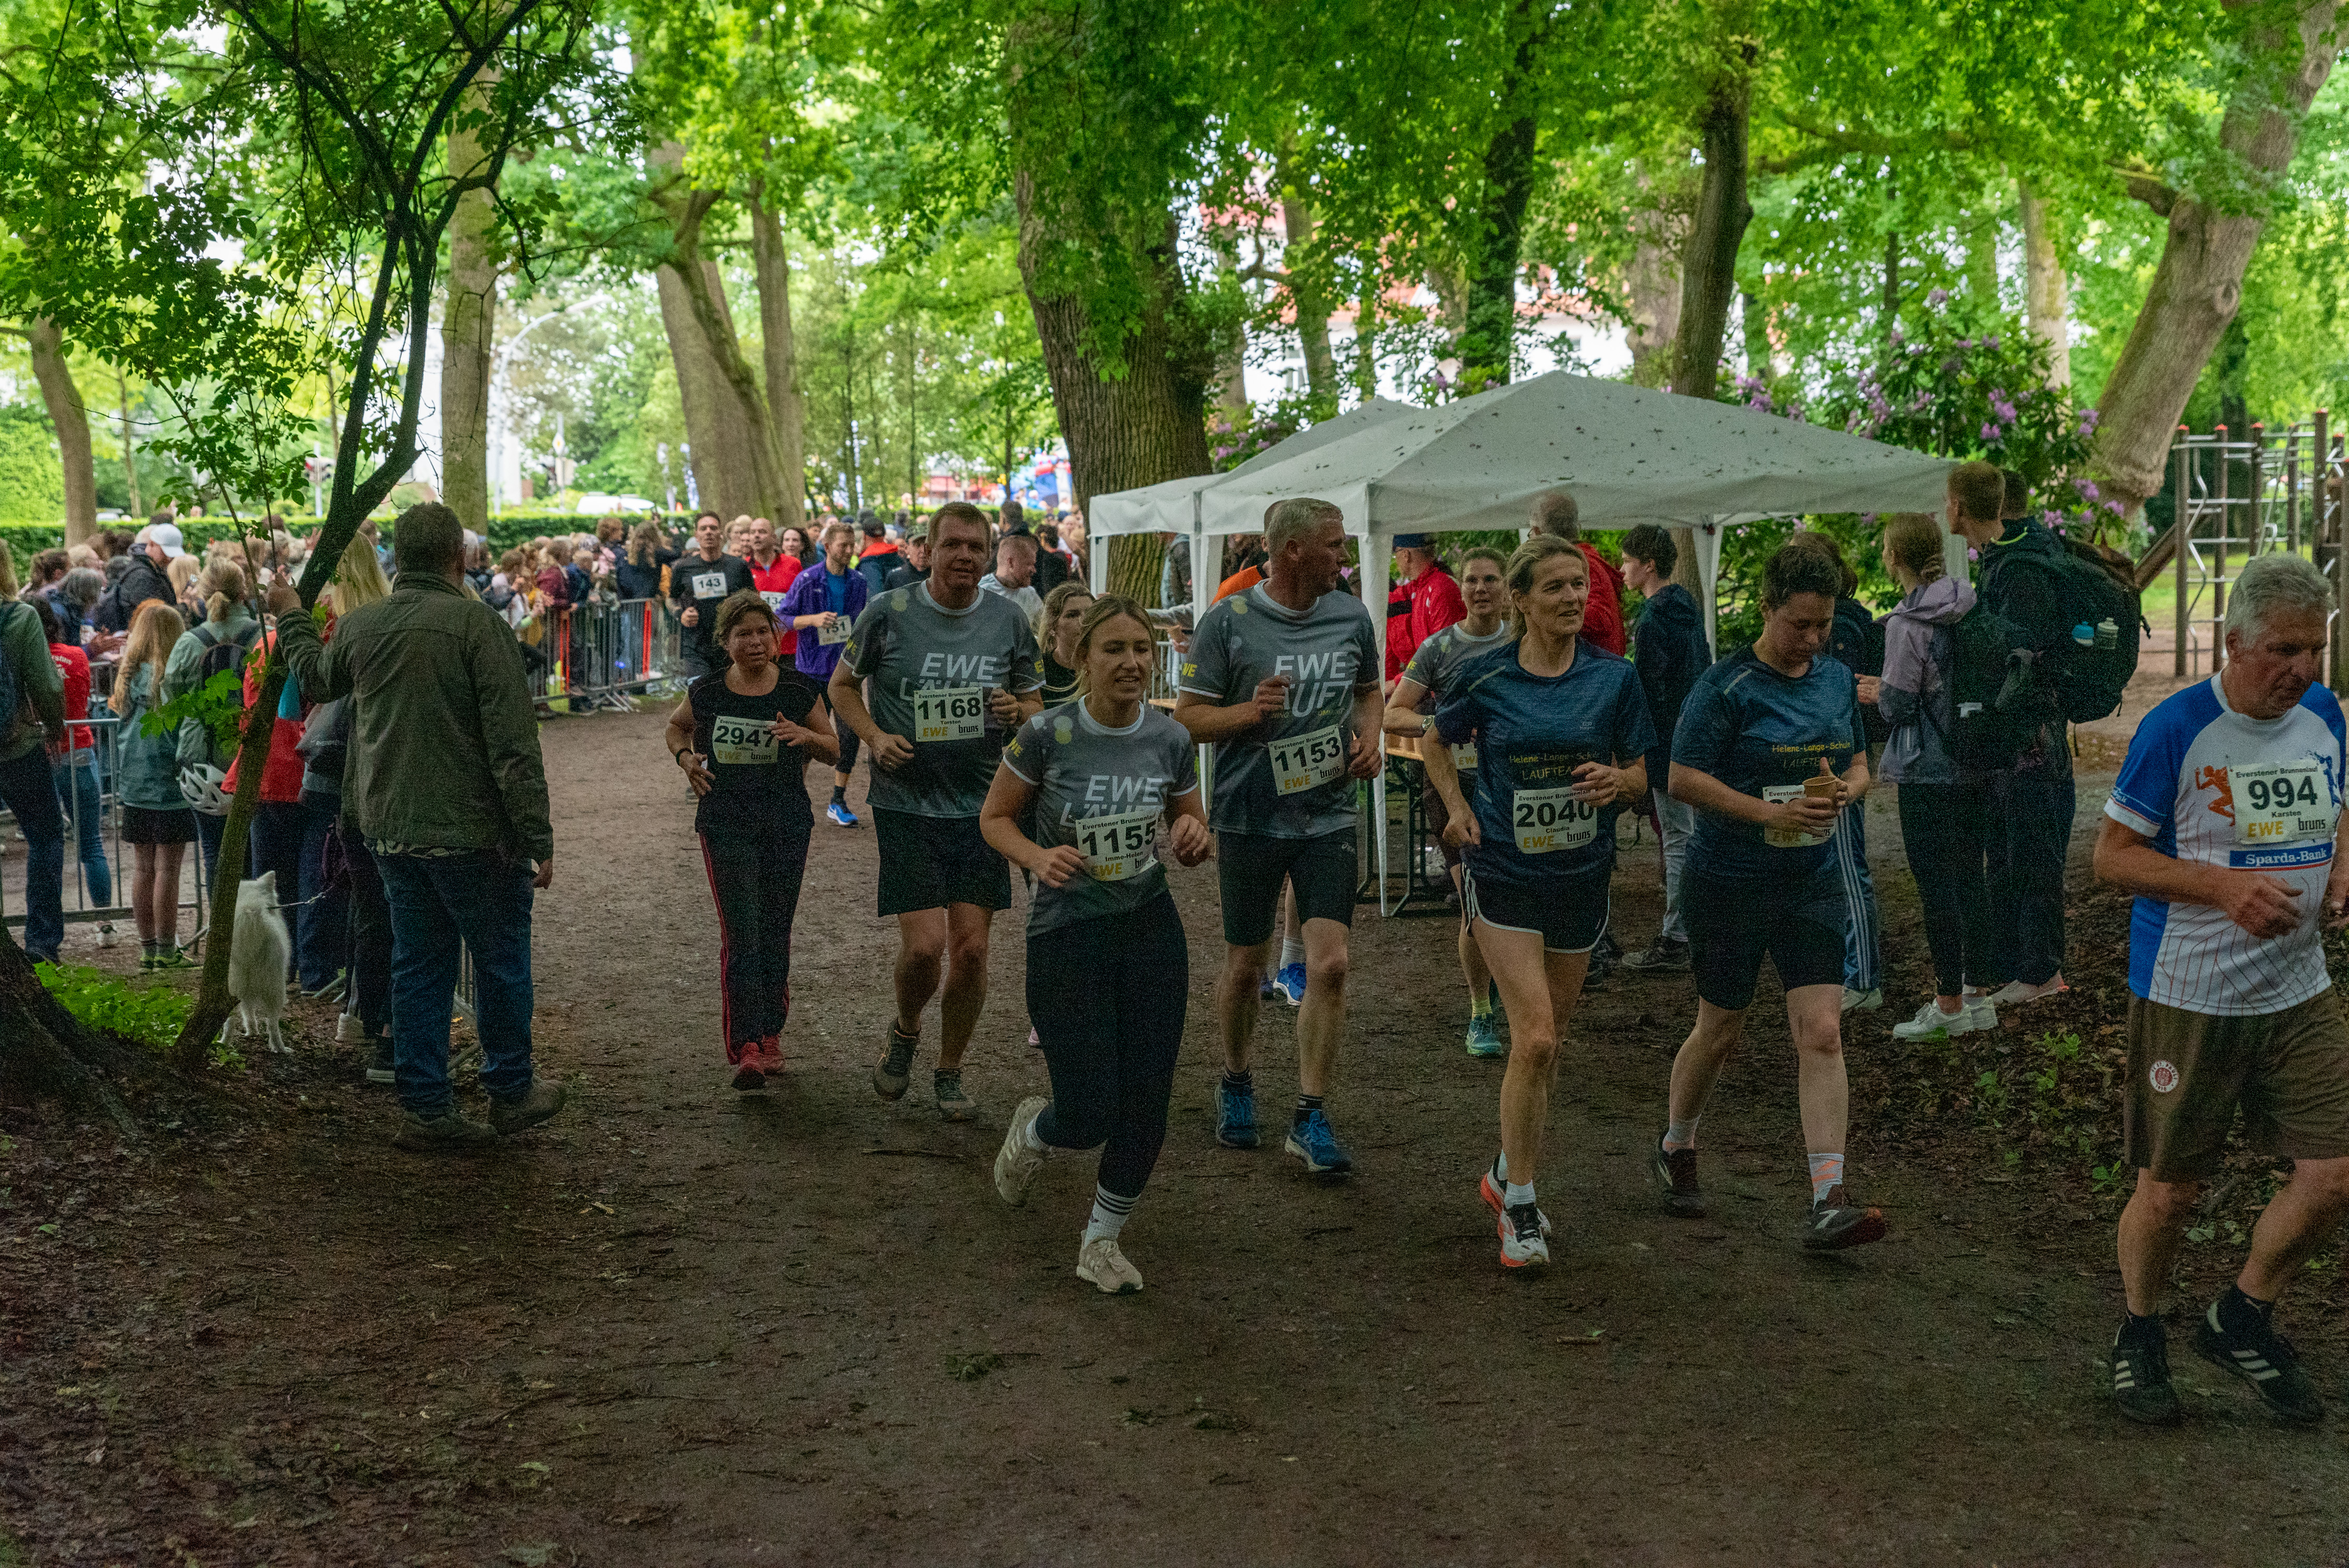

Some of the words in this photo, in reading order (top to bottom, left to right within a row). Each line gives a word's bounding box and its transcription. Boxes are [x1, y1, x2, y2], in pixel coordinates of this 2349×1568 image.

[698, 578, 720, 588] 143
[920, 652, 997, 680] EWE
[918, 697, 981, 720] 1168
[922, 726, 948, 738] EWE
[958, 724, 979, 733] bruns
[714, 725, 776, 748] 2947
[1274, 740, 1305, 751] Everstener
[1306, 729, 1335, 743] Brunnenlauf
[1275, 736, 1340, 771] 1153
[1458, 756, 1478, 766] EW
[1320, 766, 1340, 779] bruns
[1522, 766, 1576, 780] LAUFTEA
[2236, 769, 2278, 778] Everstener
[2280, 766, 2318, 775] Brunnenlauf
[1085, 775, 1163, 803] EWE
[1284, 774, 1311, 790] EWE
[1555, 789, 1591, 799] Brunnenlau
[2248, 776, 2318, 810] 994
[1516, 799, 1594, 827] 2040
[1082, 820, 1119, 830] Everstener
[2248, 821, 2284, 838] EWE
[2298, 817, 2326, 830] bruns
[1082, 821, 1157, 856] 1155
[1523, 835, 1555, 848] EWE
[1567, 830, 1591, 842] bruns
[1105, 851, 1144, 862] Imme-Helen
[2246, 848, 2327, 867] Sparda-Bank
